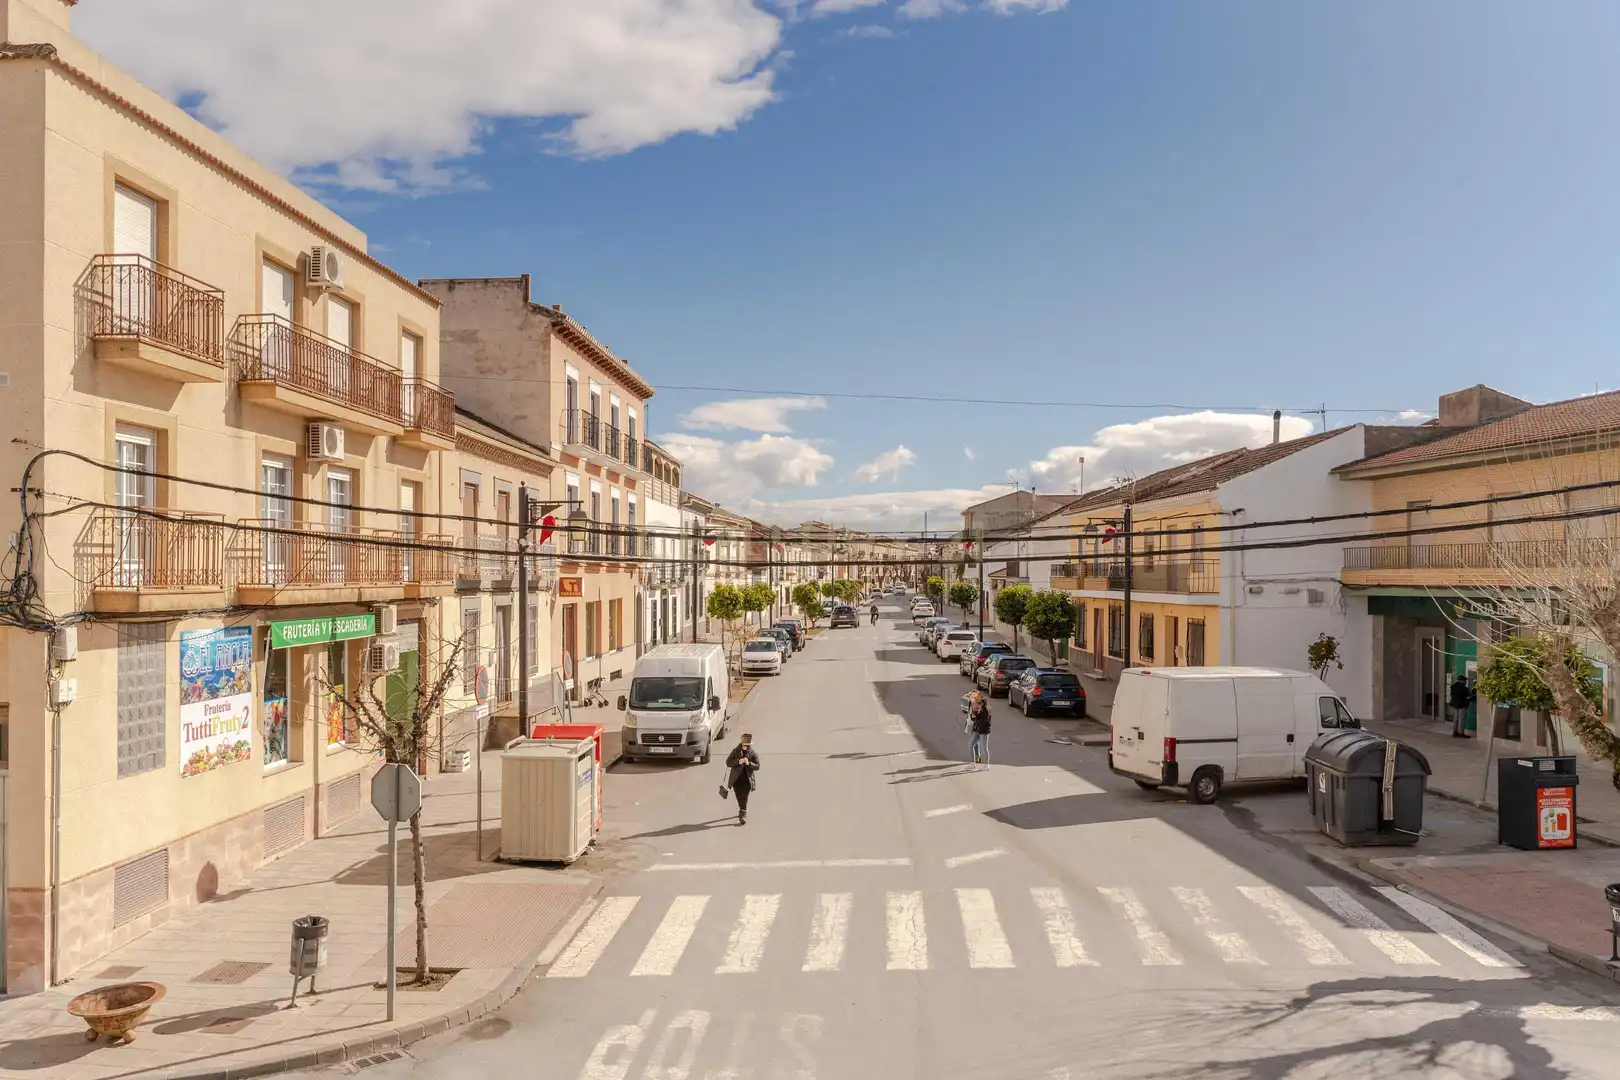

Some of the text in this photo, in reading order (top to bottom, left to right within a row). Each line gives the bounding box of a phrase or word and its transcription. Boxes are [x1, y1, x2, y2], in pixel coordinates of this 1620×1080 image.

[282, 615, 368, 640] FRUTERÍA Y PESCADERÍA
[200, 642, 250, 673] EL ANCLA
[204, 700, 231, 716] Frutería
